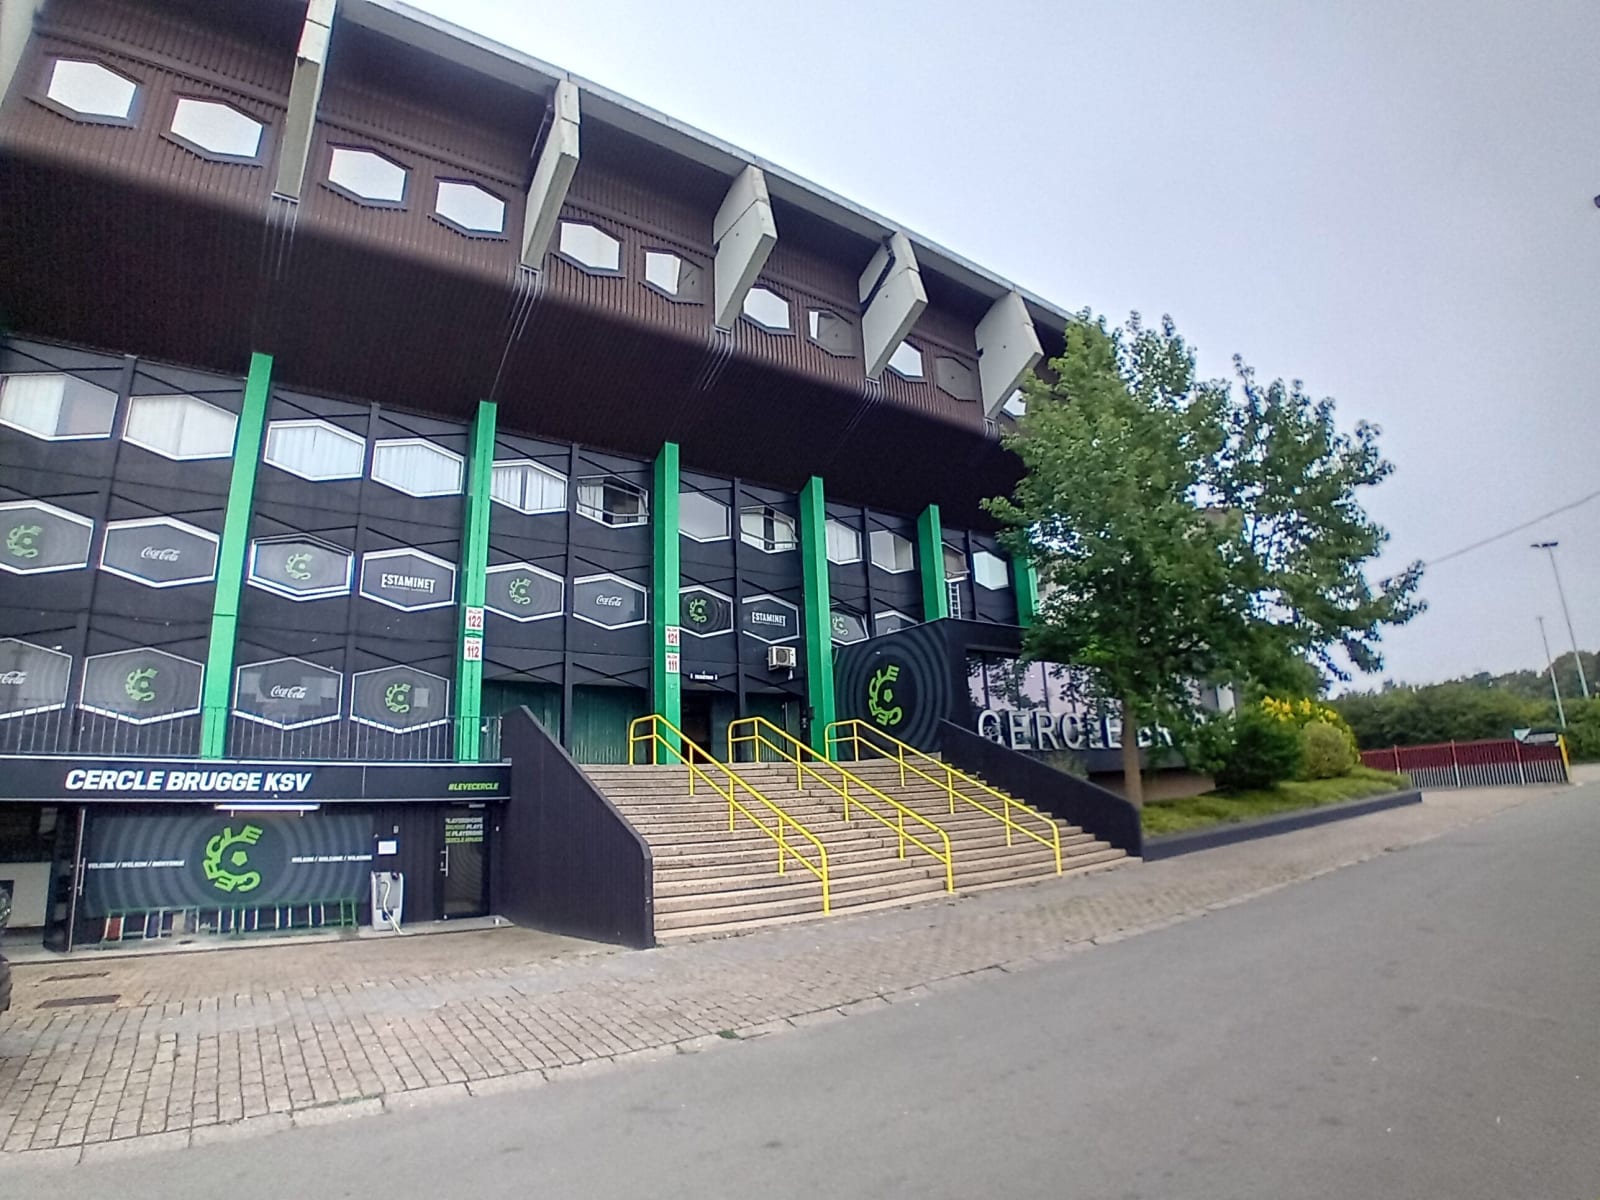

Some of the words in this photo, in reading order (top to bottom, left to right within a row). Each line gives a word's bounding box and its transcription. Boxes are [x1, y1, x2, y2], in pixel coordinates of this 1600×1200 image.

[381, 573, 437, 594] ESTAMINET
[468, 615, 482, 628] 122
[752, 611, 786, 627] ESTAMINET
[667, 632, 678, 644] 121
[467, 645, 480, 658] 112
[668, 660, 678, 671] 111
[65, 769, 165, 791] CERCLE
[165, 771, 263, 792] BRUGGE
[263, 772, 312, 792] KSV
